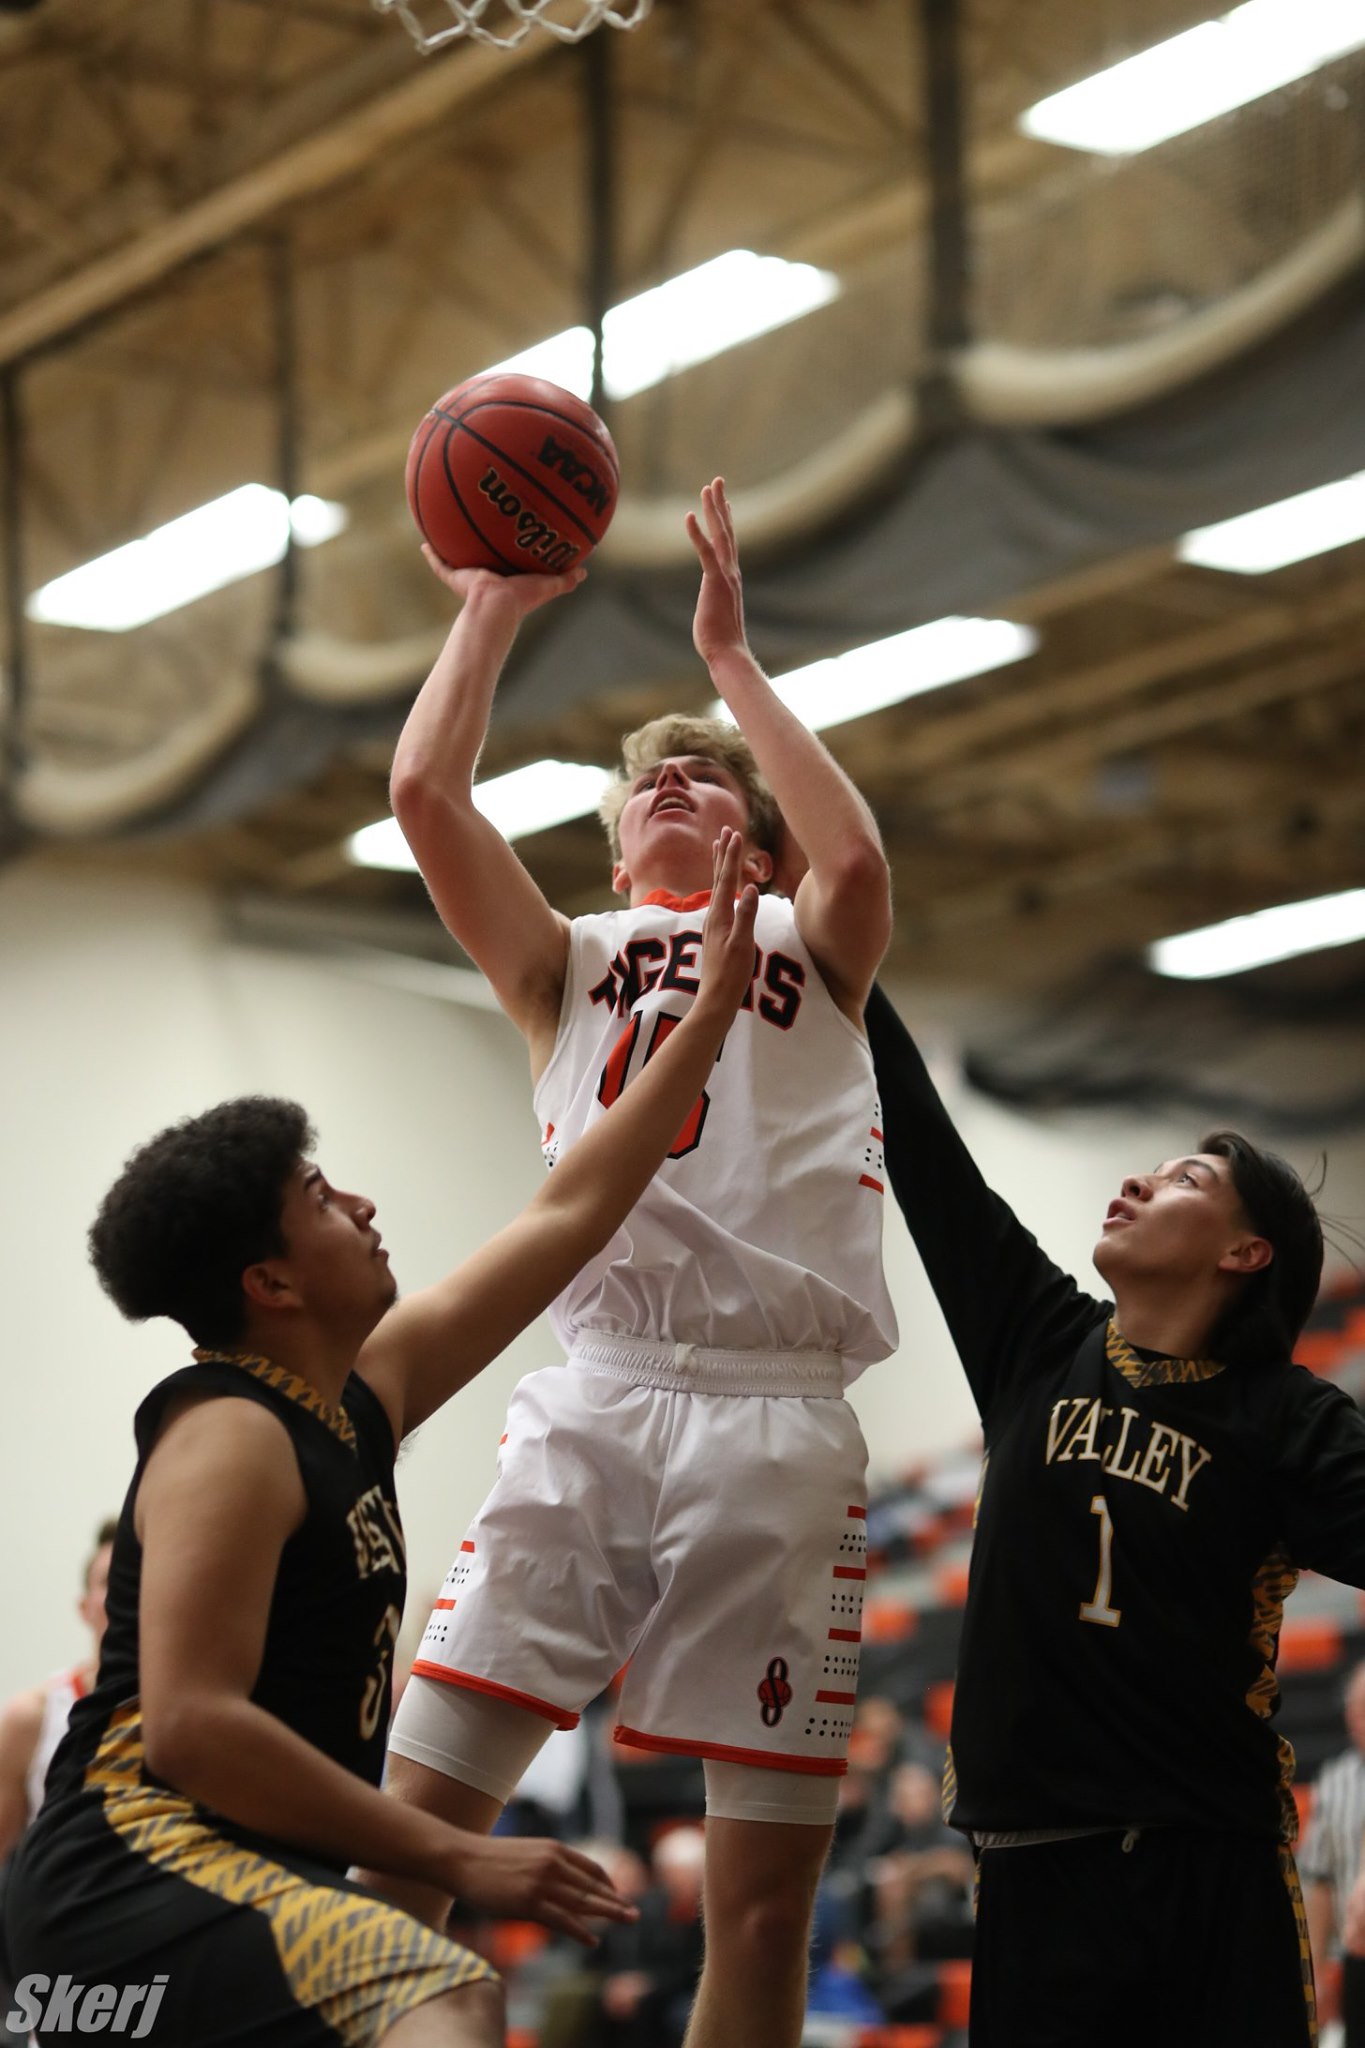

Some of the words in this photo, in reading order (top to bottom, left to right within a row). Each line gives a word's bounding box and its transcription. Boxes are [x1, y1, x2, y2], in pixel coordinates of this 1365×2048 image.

[478, 466, 581, 571] Wilson
[588, 930, 806, 1031] TIGES
[1045, 1398, 1212, 1512] VALLEY
[1079, 1495, 1121, 1627] 1
